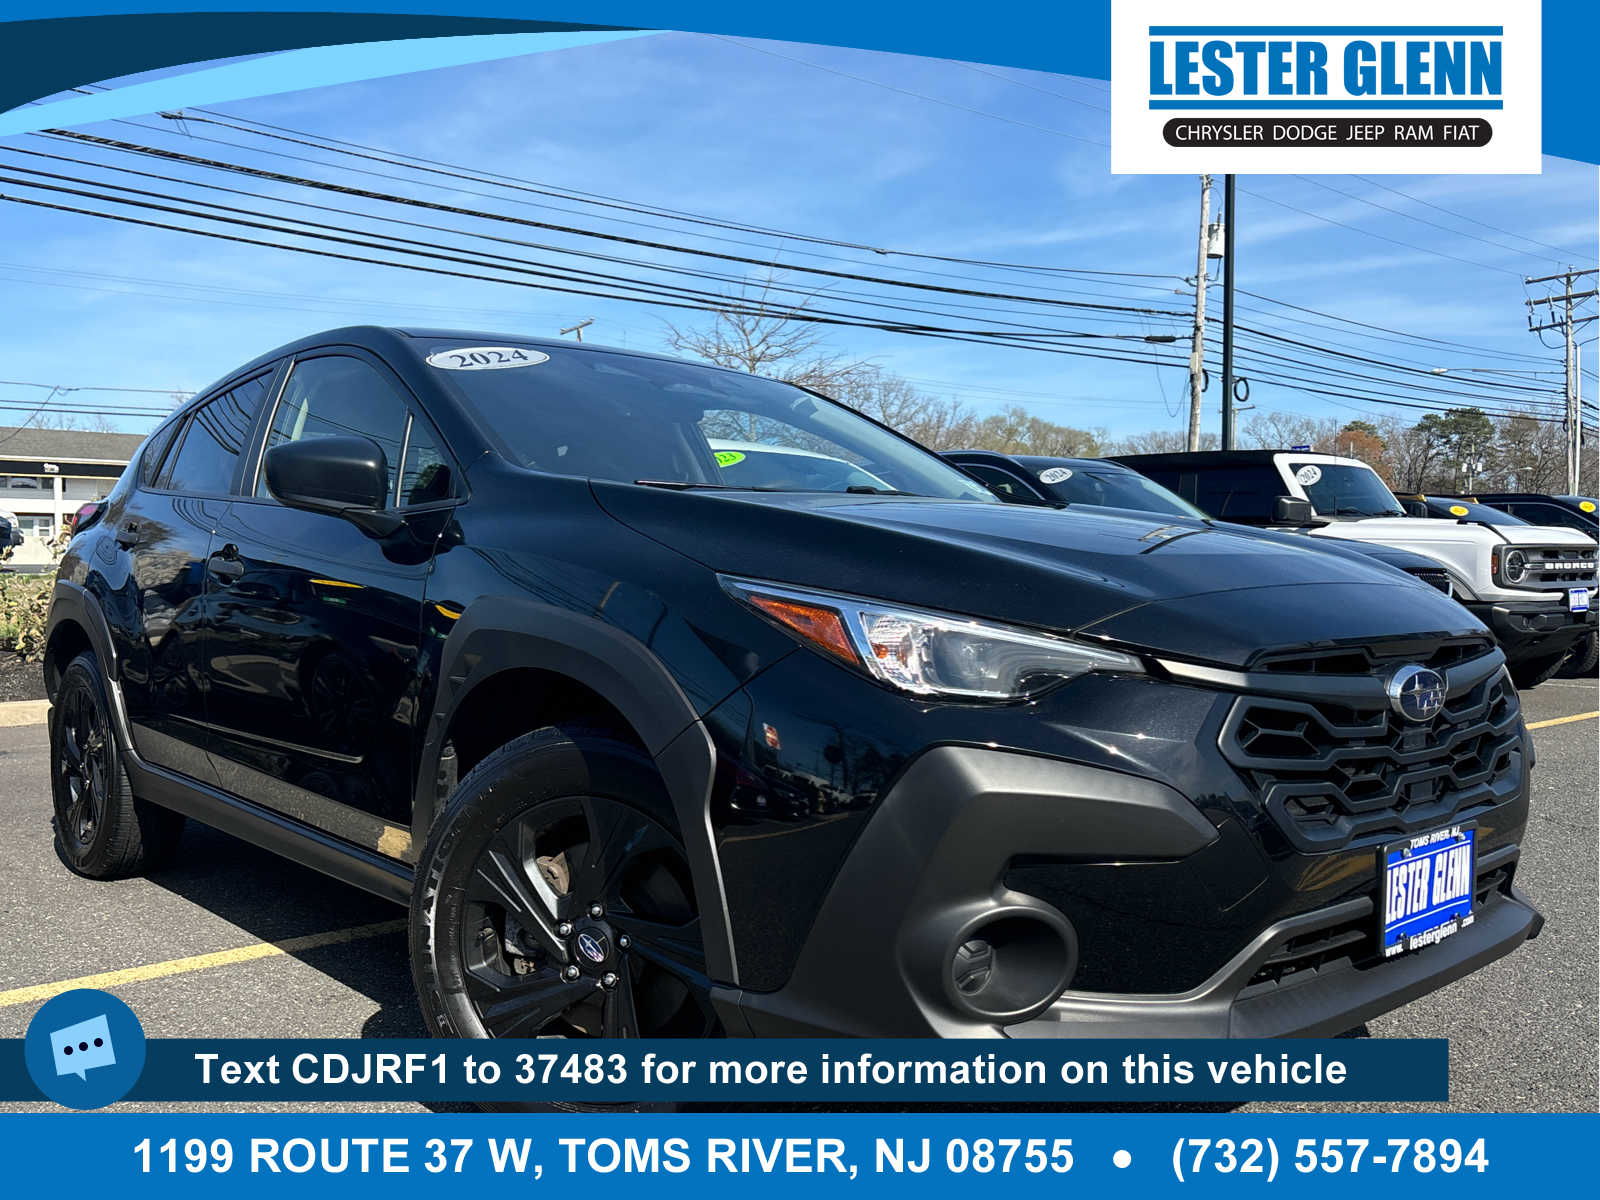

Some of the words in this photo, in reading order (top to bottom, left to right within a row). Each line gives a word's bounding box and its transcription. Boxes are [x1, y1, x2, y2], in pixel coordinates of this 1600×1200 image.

[450, 349, 529, 368] 2024
[1046, 468, 1067, 482] 2024
[1299, 466, 1318, 484] 2024
[1544, 562, 1595, 570] BRONCO
[1409, 835, 1430, 850] TOMS
[1385, 857, 1431, 925] LESTER
[1432, 844, 1471, 906] GLENN
[1409, 922, 1458, 950] lesterglenn
